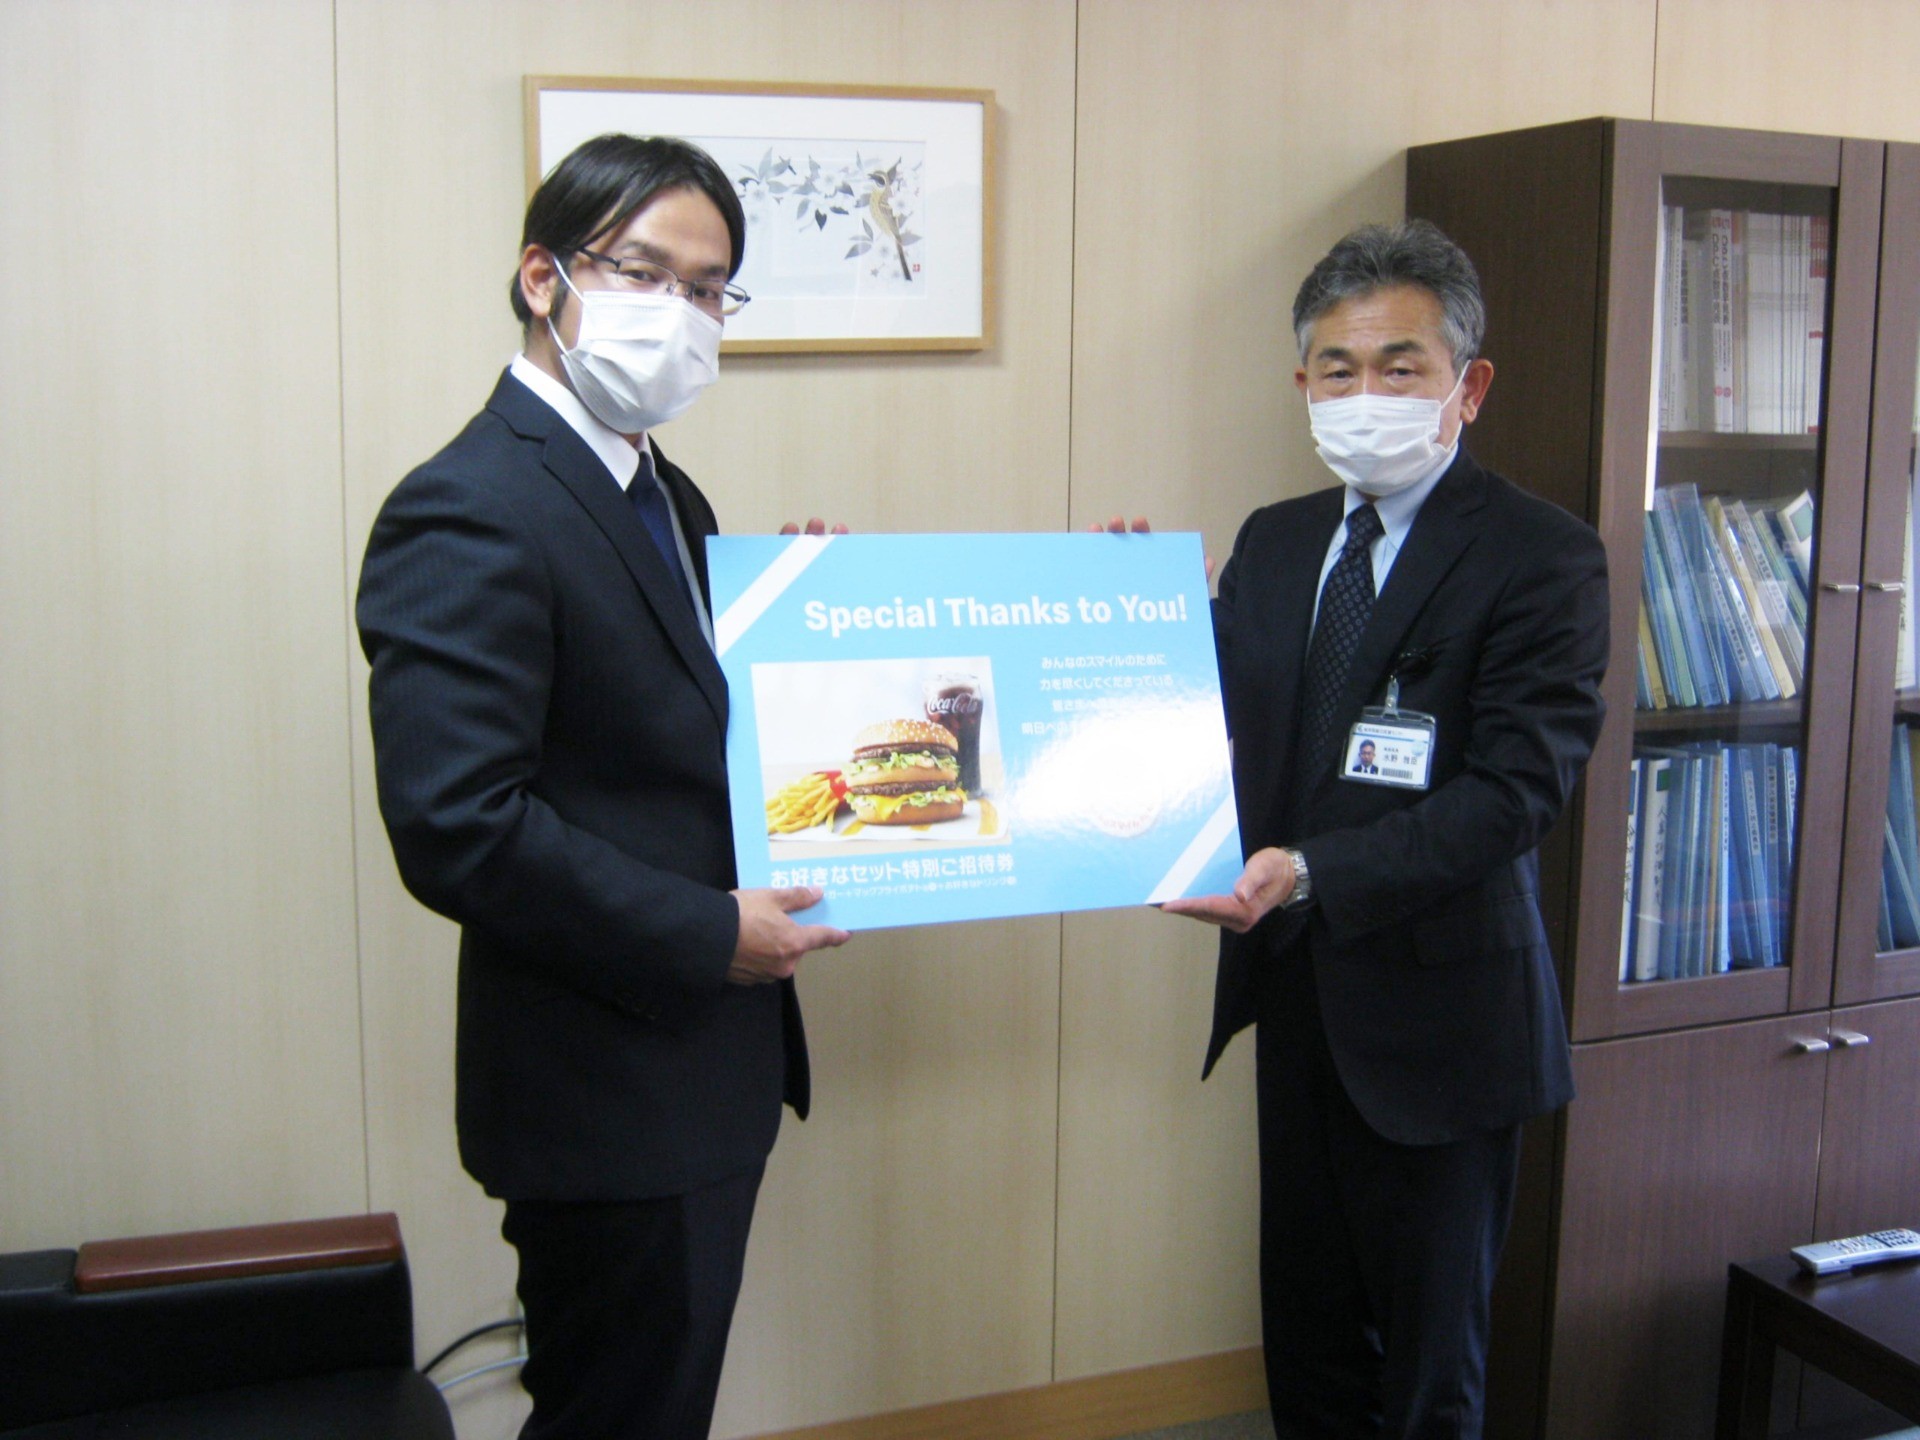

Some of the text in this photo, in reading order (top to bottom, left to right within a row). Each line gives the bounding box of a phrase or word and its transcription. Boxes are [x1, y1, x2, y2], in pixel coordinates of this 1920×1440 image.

[803, 594, 1187, 639] Special Thanks to You!
[1041, 654, 1167, 669] みんなのスマイルのために
[769, 852, 1015, 890] お好きなセット特別ご招待券
